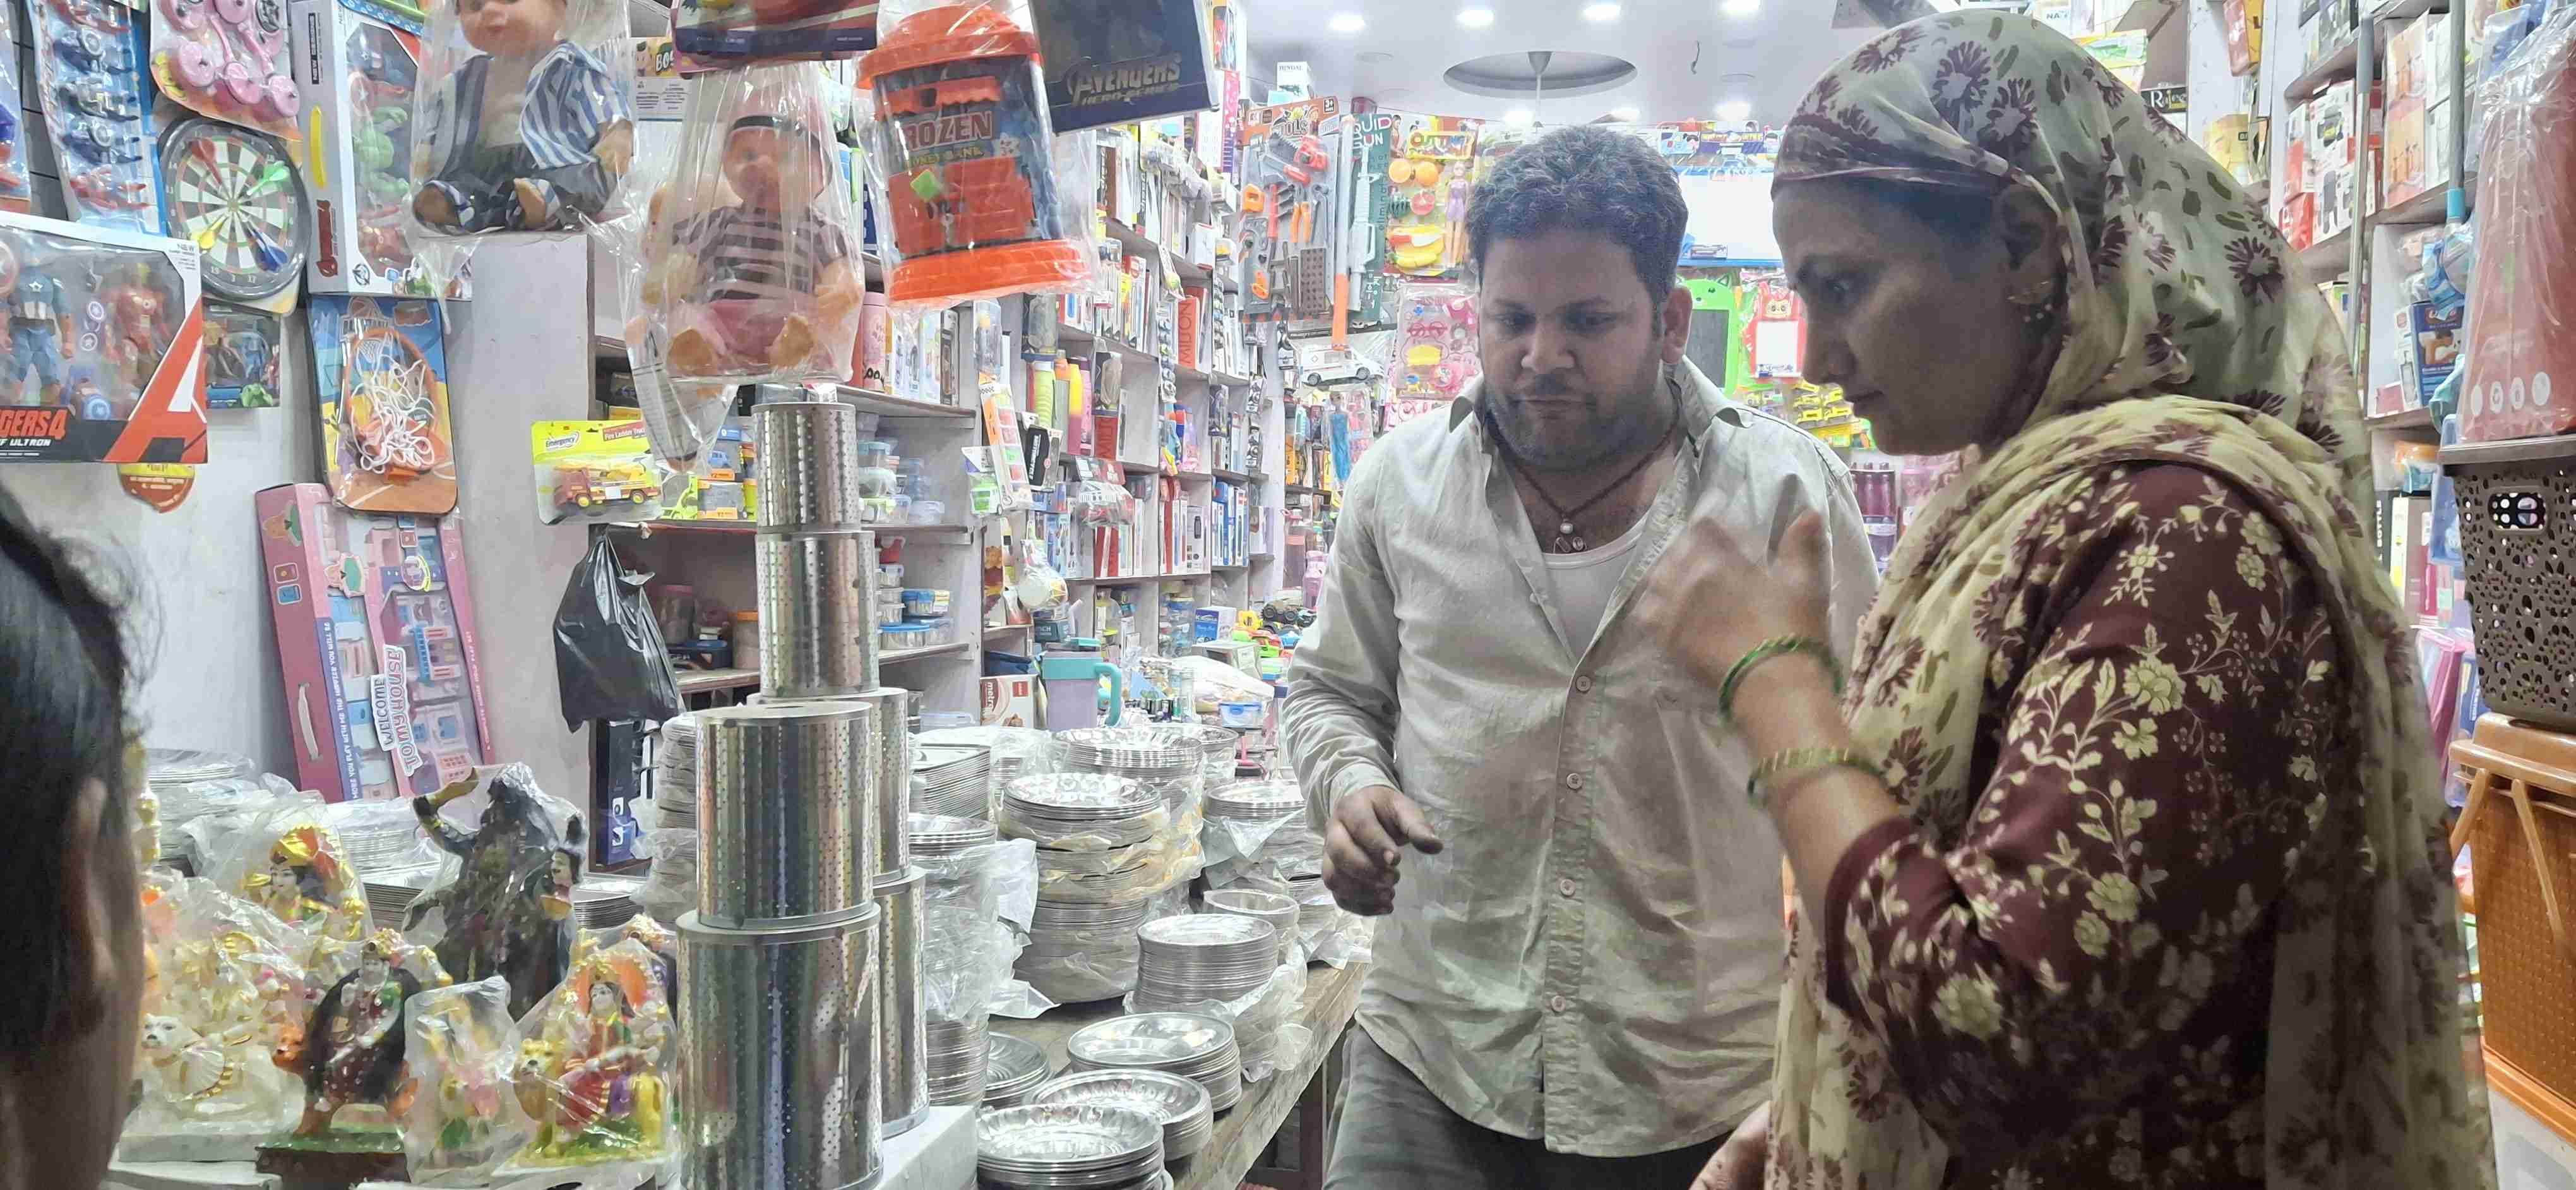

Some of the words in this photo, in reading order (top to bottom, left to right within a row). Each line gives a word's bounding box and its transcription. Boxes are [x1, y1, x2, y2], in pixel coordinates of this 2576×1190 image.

[900, 111, 993, 152] ROZEN
[9, 438, 51, 447] ULTRON
[546, 436, 576, 448] Emergency
[324, 622, 331, 631] BE
[325, 632, 333, 650] WILL
[388, 649, 404, 713] HOUSE
[336, 698, 344, 711] THE
[374, 678, 395, 746] WELCOME
[338, 712, 345, 723] ME
[340, 724, 349, 743] WITH
[394, 714, 410, 743] MY
[344, 745, 352, 762] PLAY
[400, 743, 419, 771] TO
[350, 779, 359, 799] MORE
